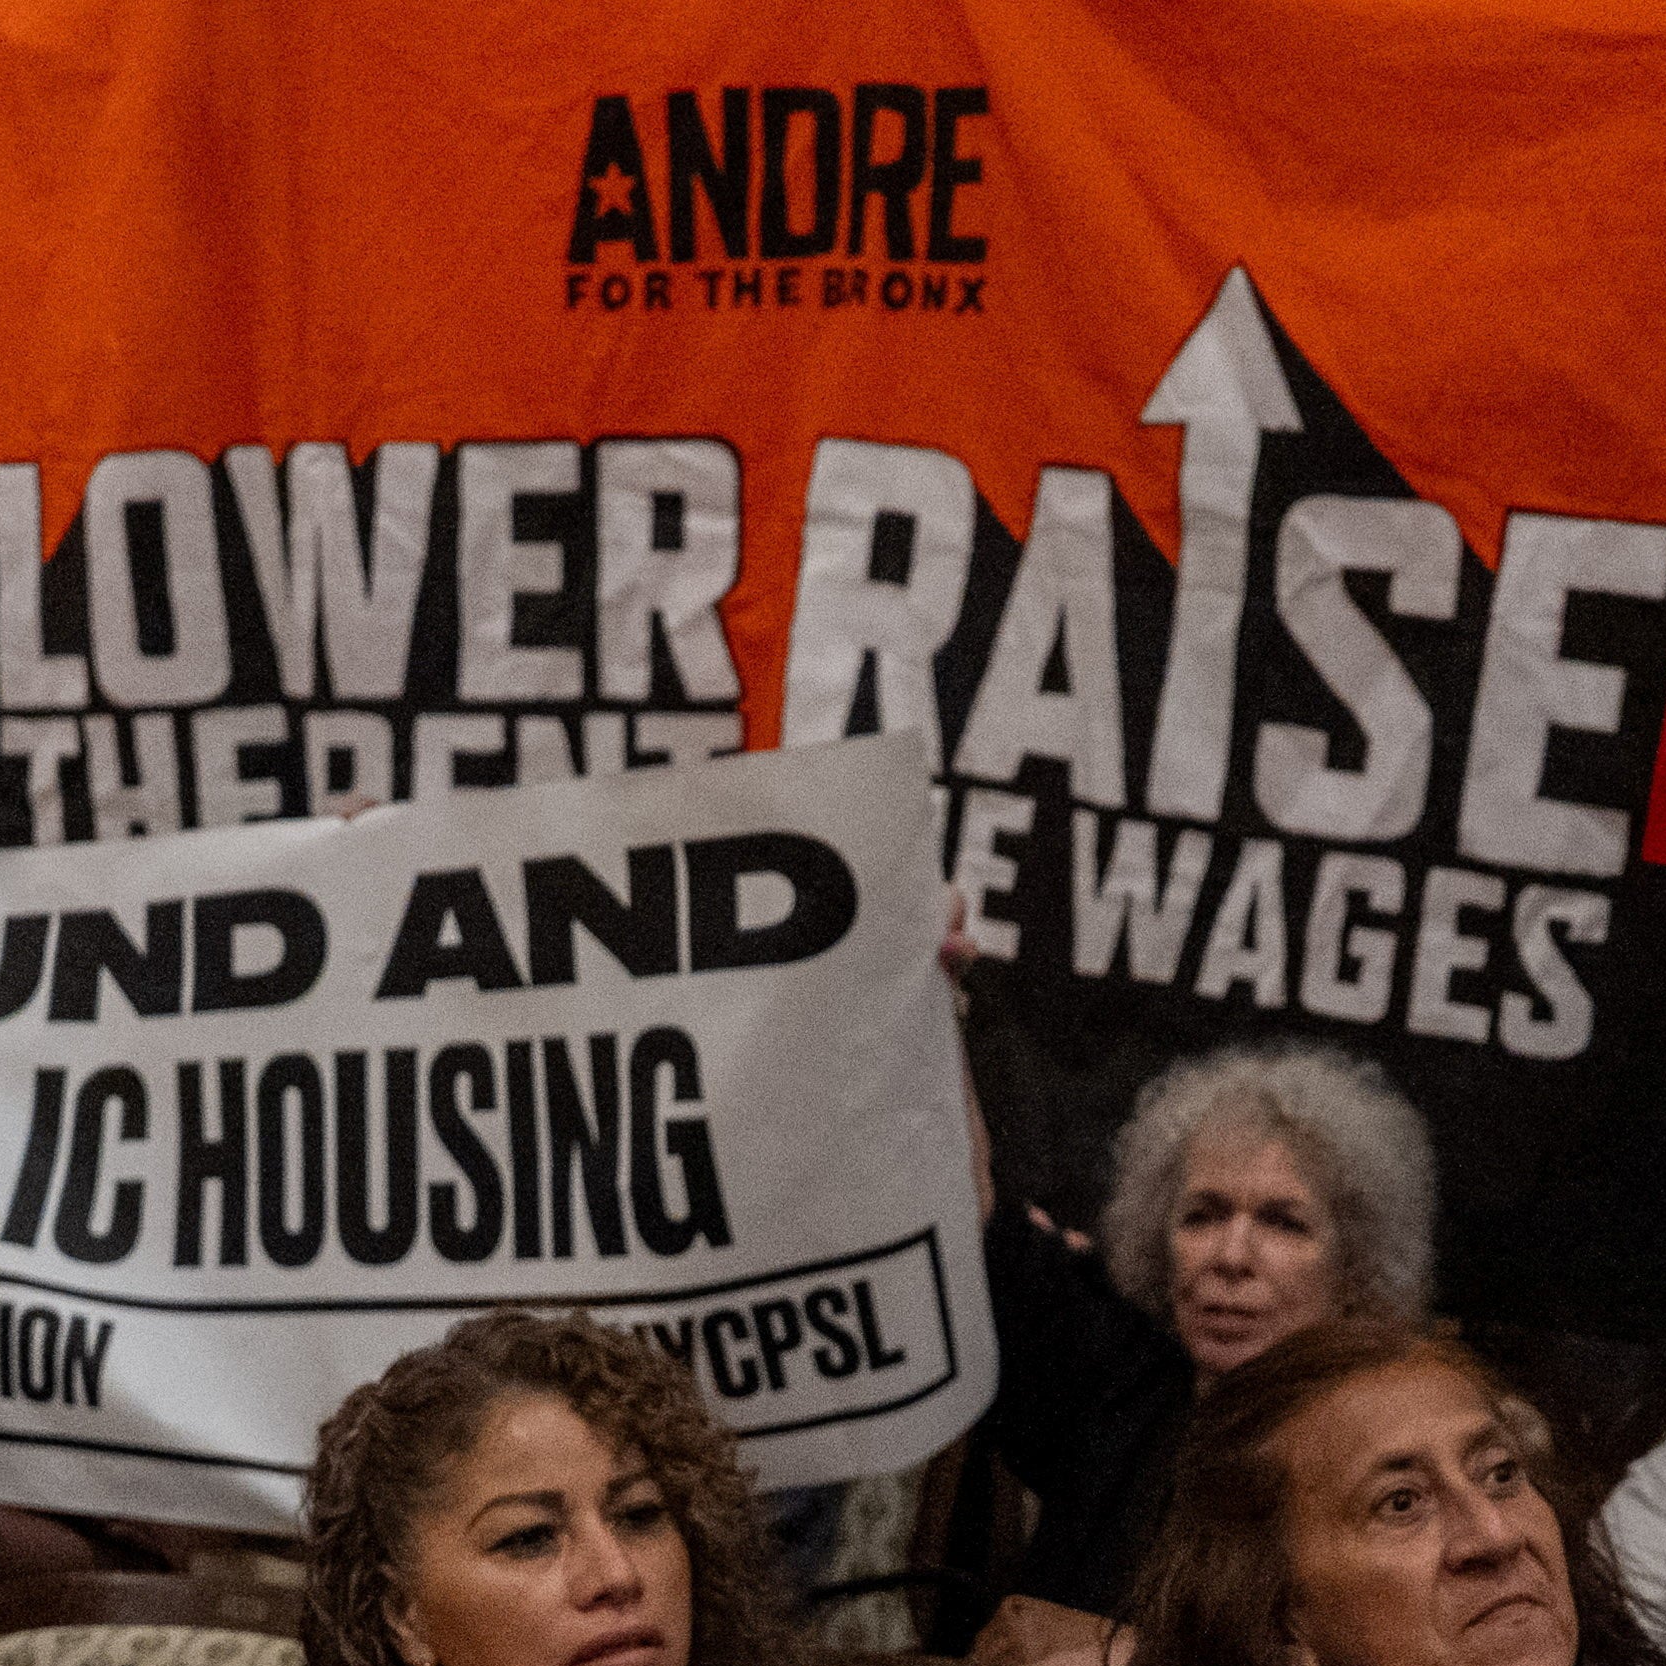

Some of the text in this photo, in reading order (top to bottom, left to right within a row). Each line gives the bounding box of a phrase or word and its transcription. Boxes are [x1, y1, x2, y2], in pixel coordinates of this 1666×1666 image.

[567, 82, 990, 264] ANDRE
[565, 267, 987, 314] FOR THE BRONX
[0, 705, 289, 848] THE
[371, 831, 859, 1003] AND
[1071, 808, 1611, 1063] WAGES
[171, 1025, 734, 1268] HOUSING
[634, 1281, 906, 1398] YCPSL
